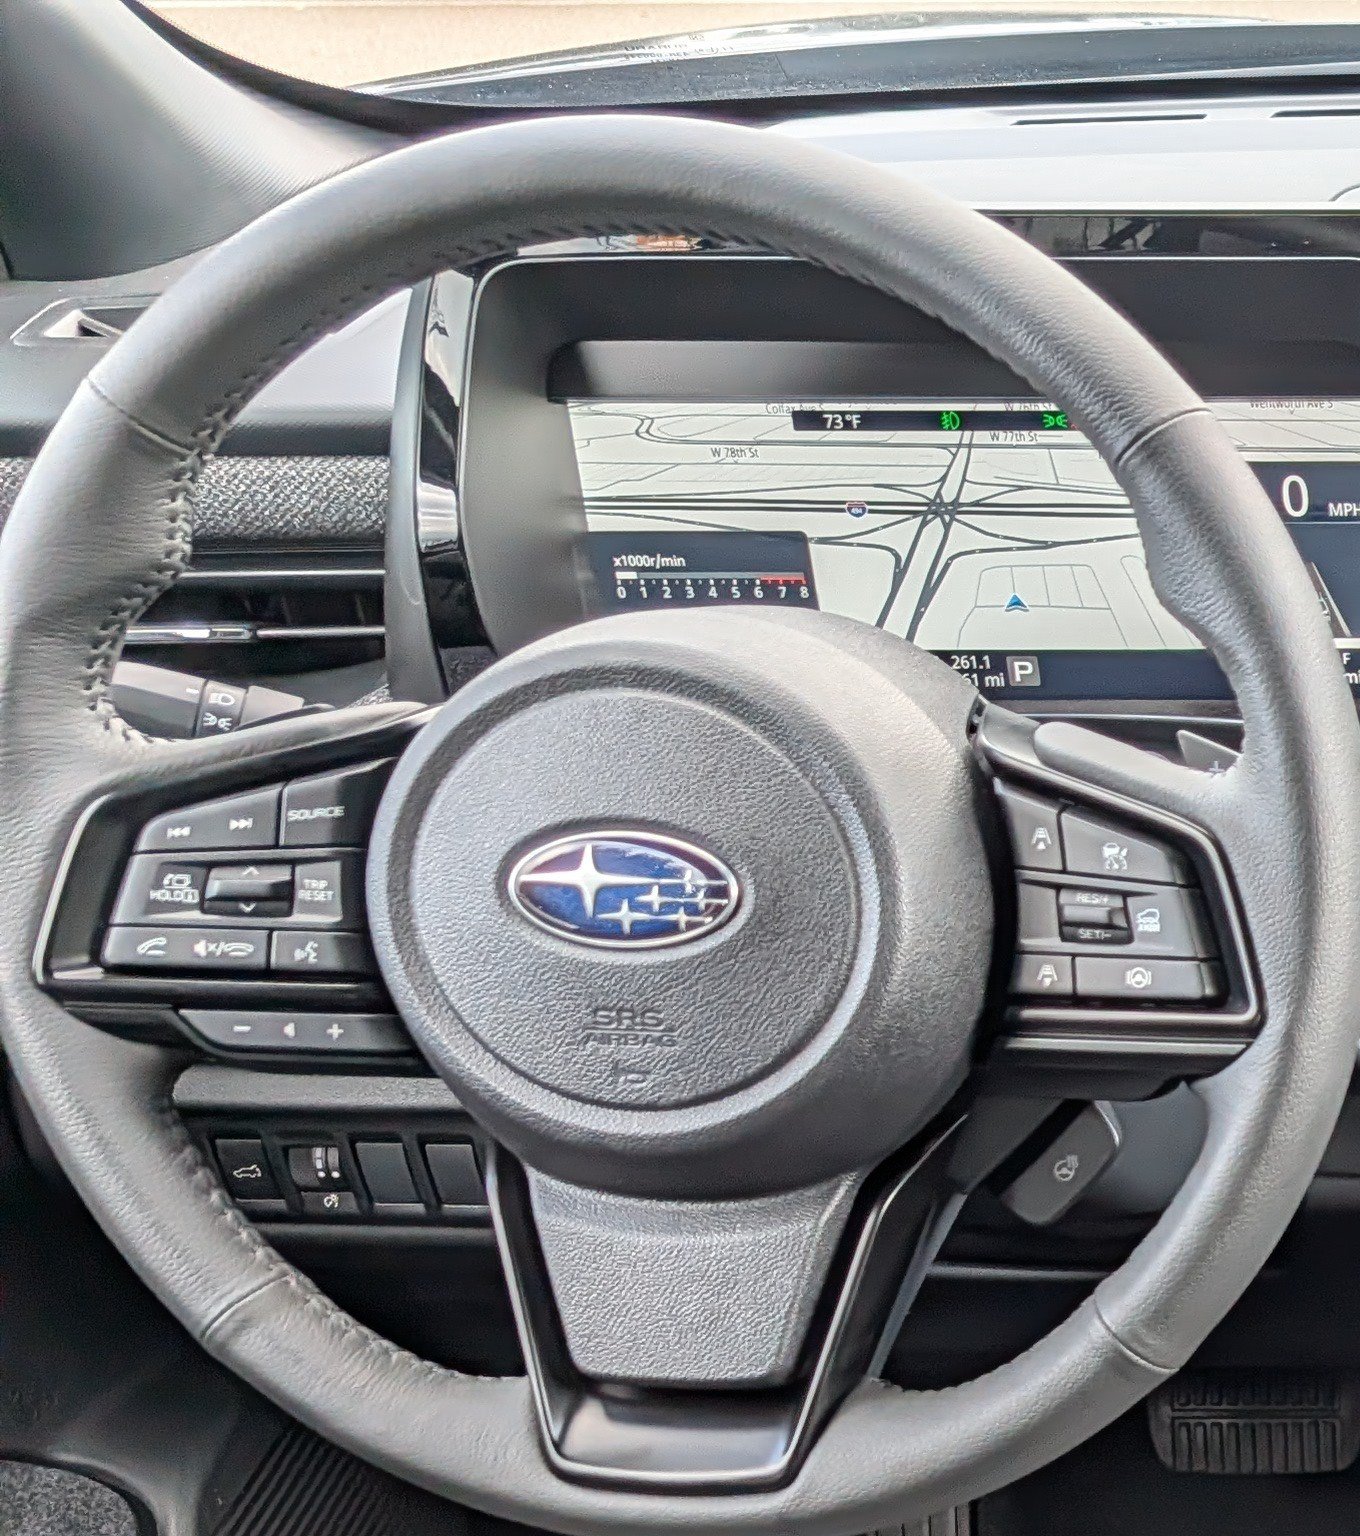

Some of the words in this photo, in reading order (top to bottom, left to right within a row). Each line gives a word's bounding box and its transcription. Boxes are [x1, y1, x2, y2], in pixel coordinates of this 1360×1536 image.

[711, 447, 721, 458] W
[749, 448, 759, 458] St
[1282, 475, 1309, 517] 0
[613, 554, 686, 569] x1000r/min
[616, 586, 627, 599] 0
[640, 586, 648, 599] 1
[662, 586, 672, 599] 2
[685, 586, 695, 599] 3
[709, 586, 718, 599] 4
[732, 586, 741, 599] 5
[754, 586, 764, 599] 6
[778, 586, 787, 599] 7
[800, 586, 809, 599] 8
[1014, 661, 1034, 682] P
[985, 672, 1005, 687] mi
[286, 806, 345, 821] SOURCE
[299, 890, 335, 901] RESET
